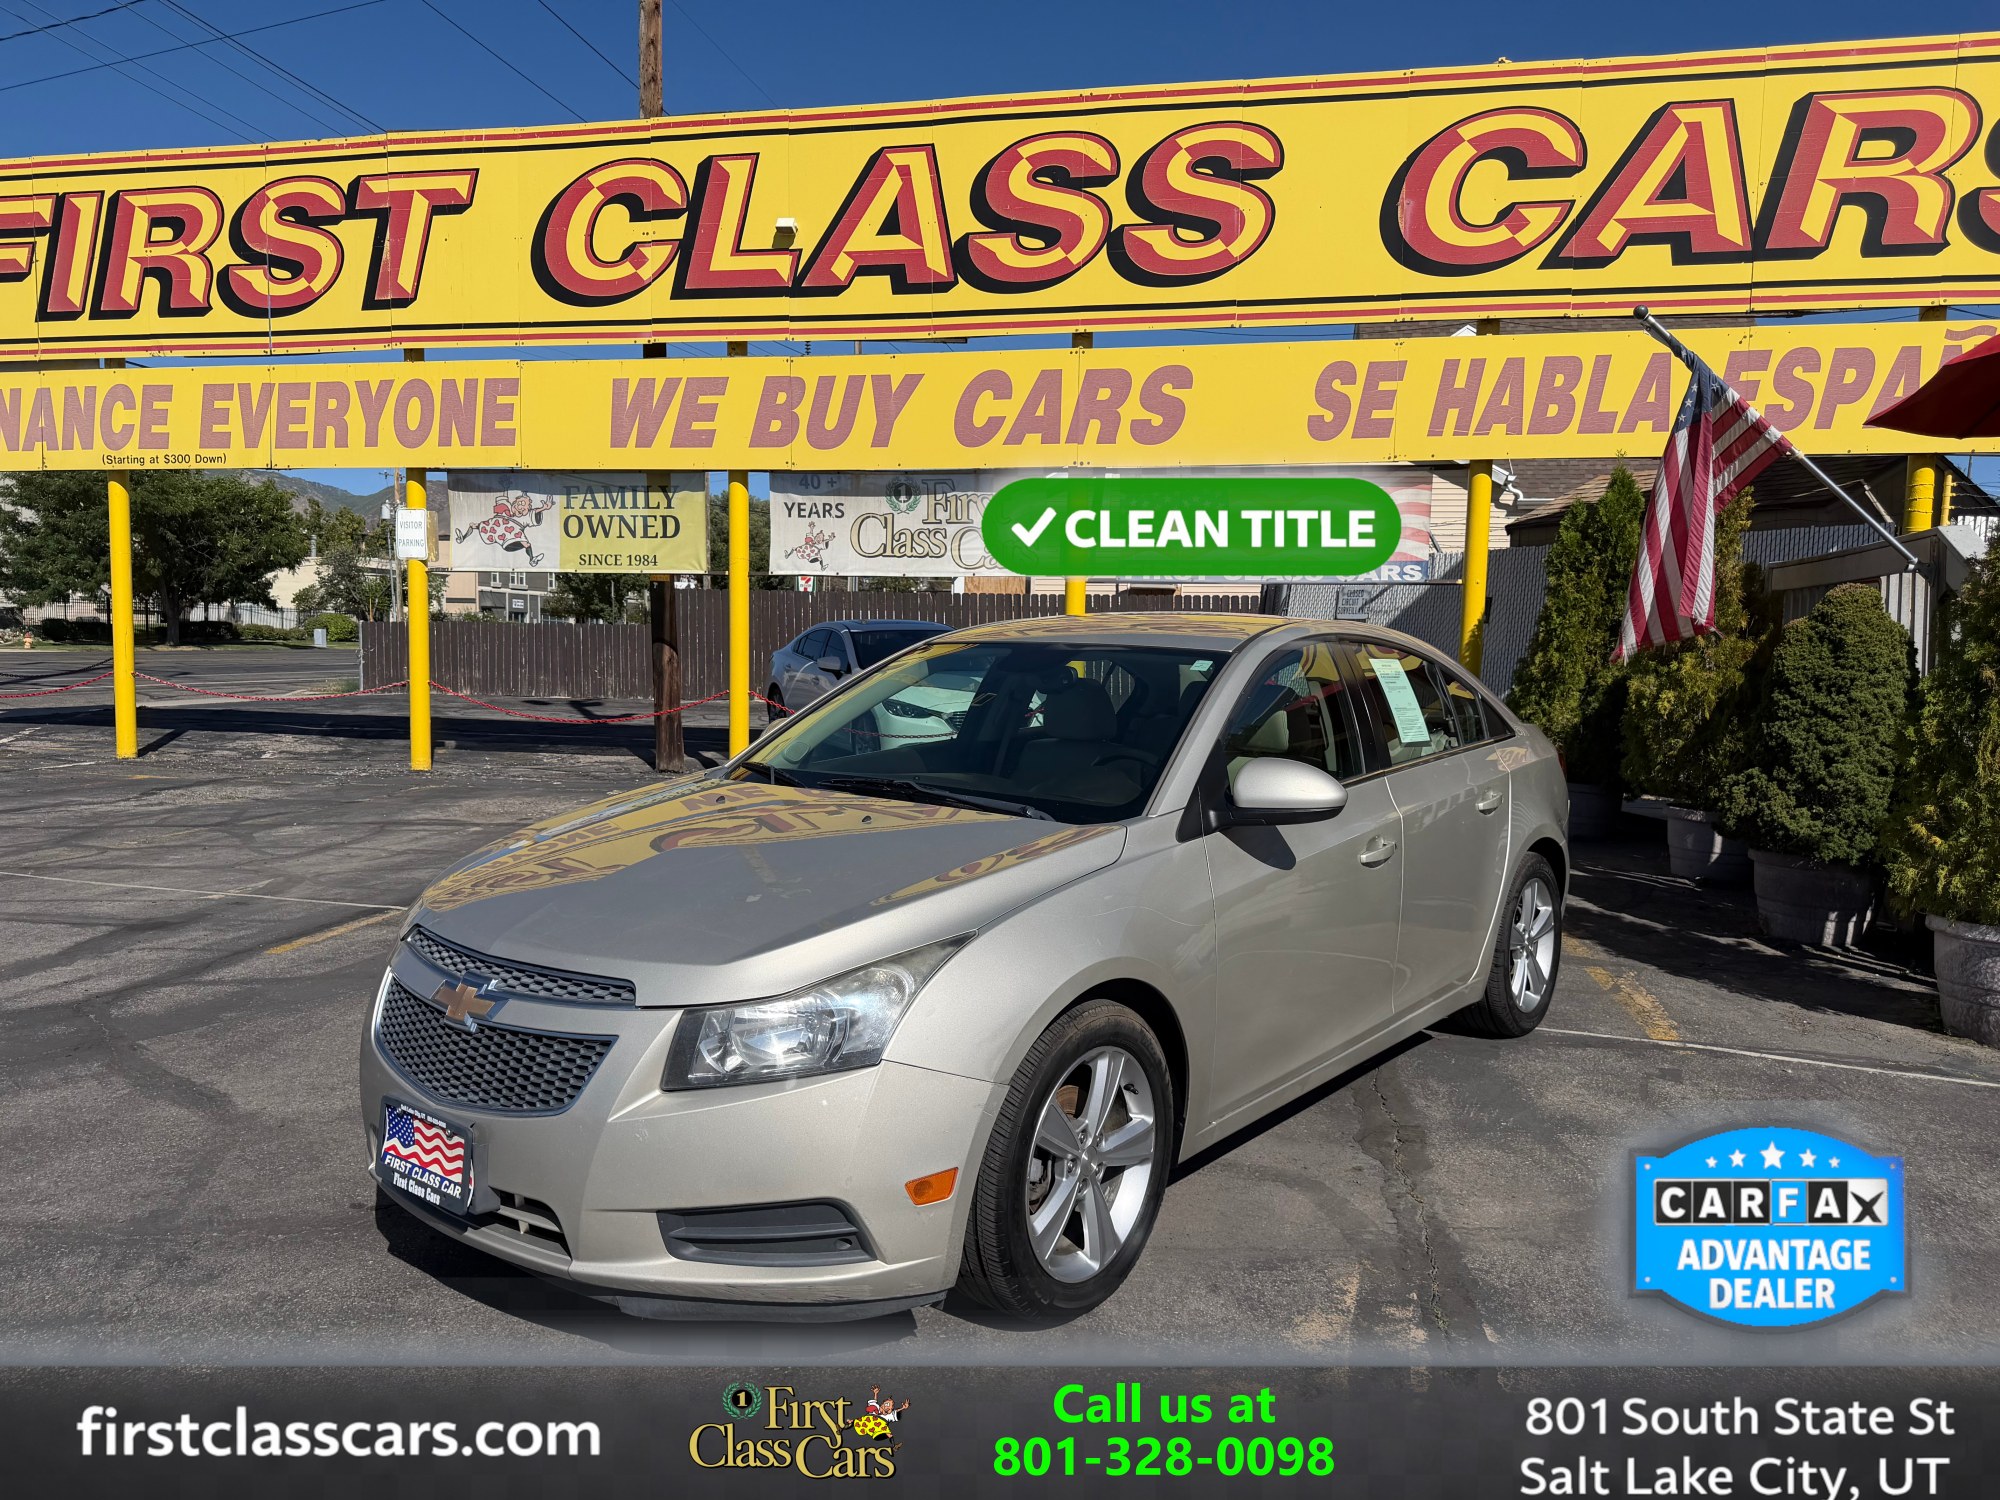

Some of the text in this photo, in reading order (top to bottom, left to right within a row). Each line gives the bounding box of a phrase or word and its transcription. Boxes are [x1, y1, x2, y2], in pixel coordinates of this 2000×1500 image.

[530, 121, 1284, 307] CLASS
[609, 364, 1194, 450] WE BUY CARS
[1306, 360, 1408, 441] SE
[1427, 353, 1672, 436] HABLA
[199, 377, 519, 448] EVERYONE
[102, 453, 227, 466] (Starting at $300 Down)
[799, 476, 820, 489] 40
[563, 485, 680, 510] FAMILY
[784, 502, 845, 519] YEARS
[921, 479, 990, 525] Fir
[400, 521, 422, 529] VISITOR
[563, 514, 680, 540] OWNED
[850, 512, 948, 559] Class
[399, 539, 424, 547] PARKING
[578, 554, 658, 567] SINCE 1984
[385, 1155, 462, 1199] FIRST CLASS CAR
[393, 1172, 440, 1205] First Class Cars
